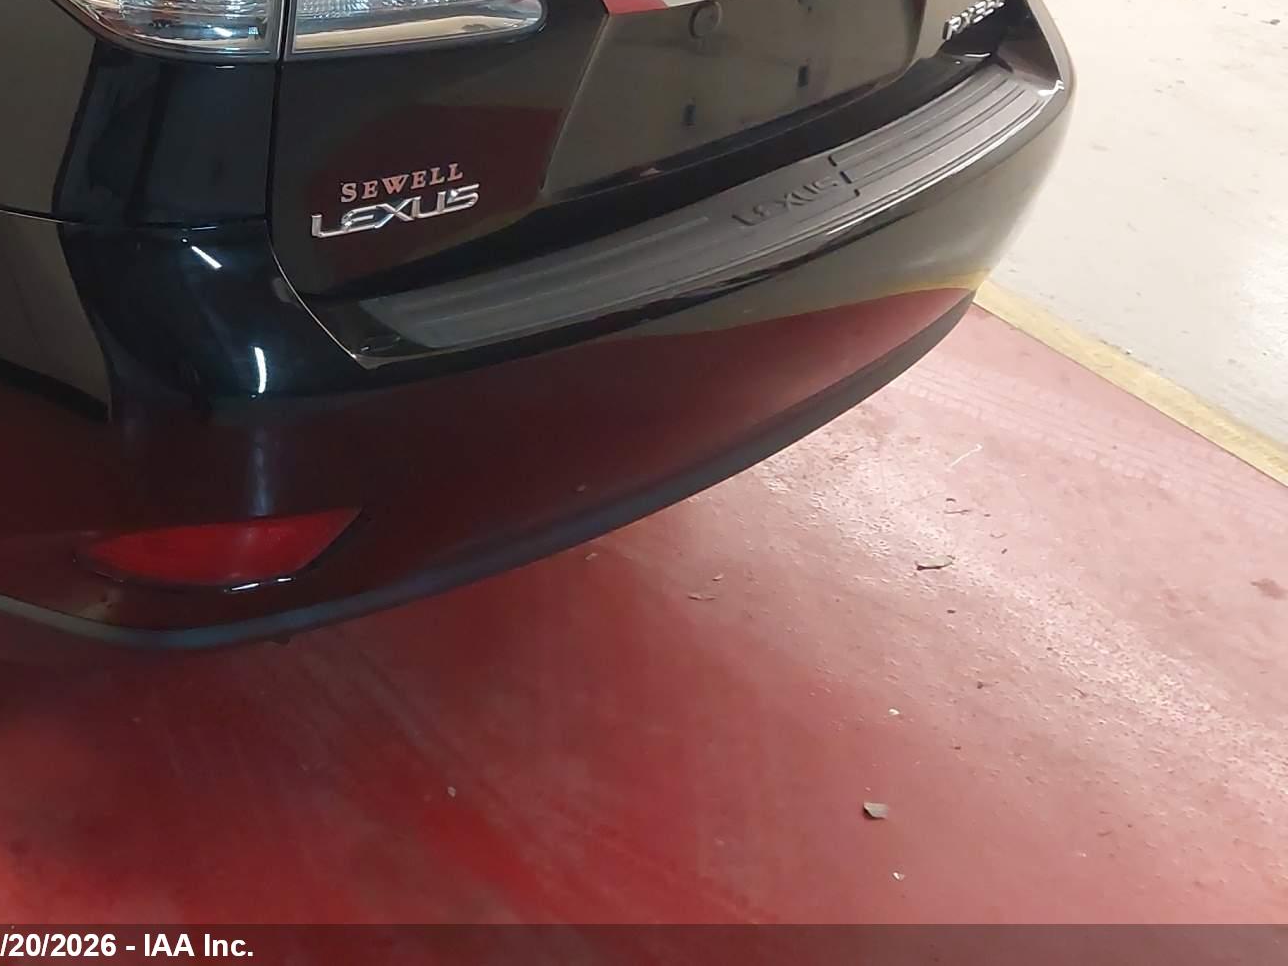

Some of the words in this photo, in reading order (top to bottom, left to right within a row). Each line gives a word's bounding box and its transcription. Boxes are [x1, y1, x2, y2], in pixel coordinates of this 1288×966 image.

[340, 162, 464, 203] SEWELL
[731, 174, 840, 229] LEXUS
[311, 183, 480, 239] LEXUS
